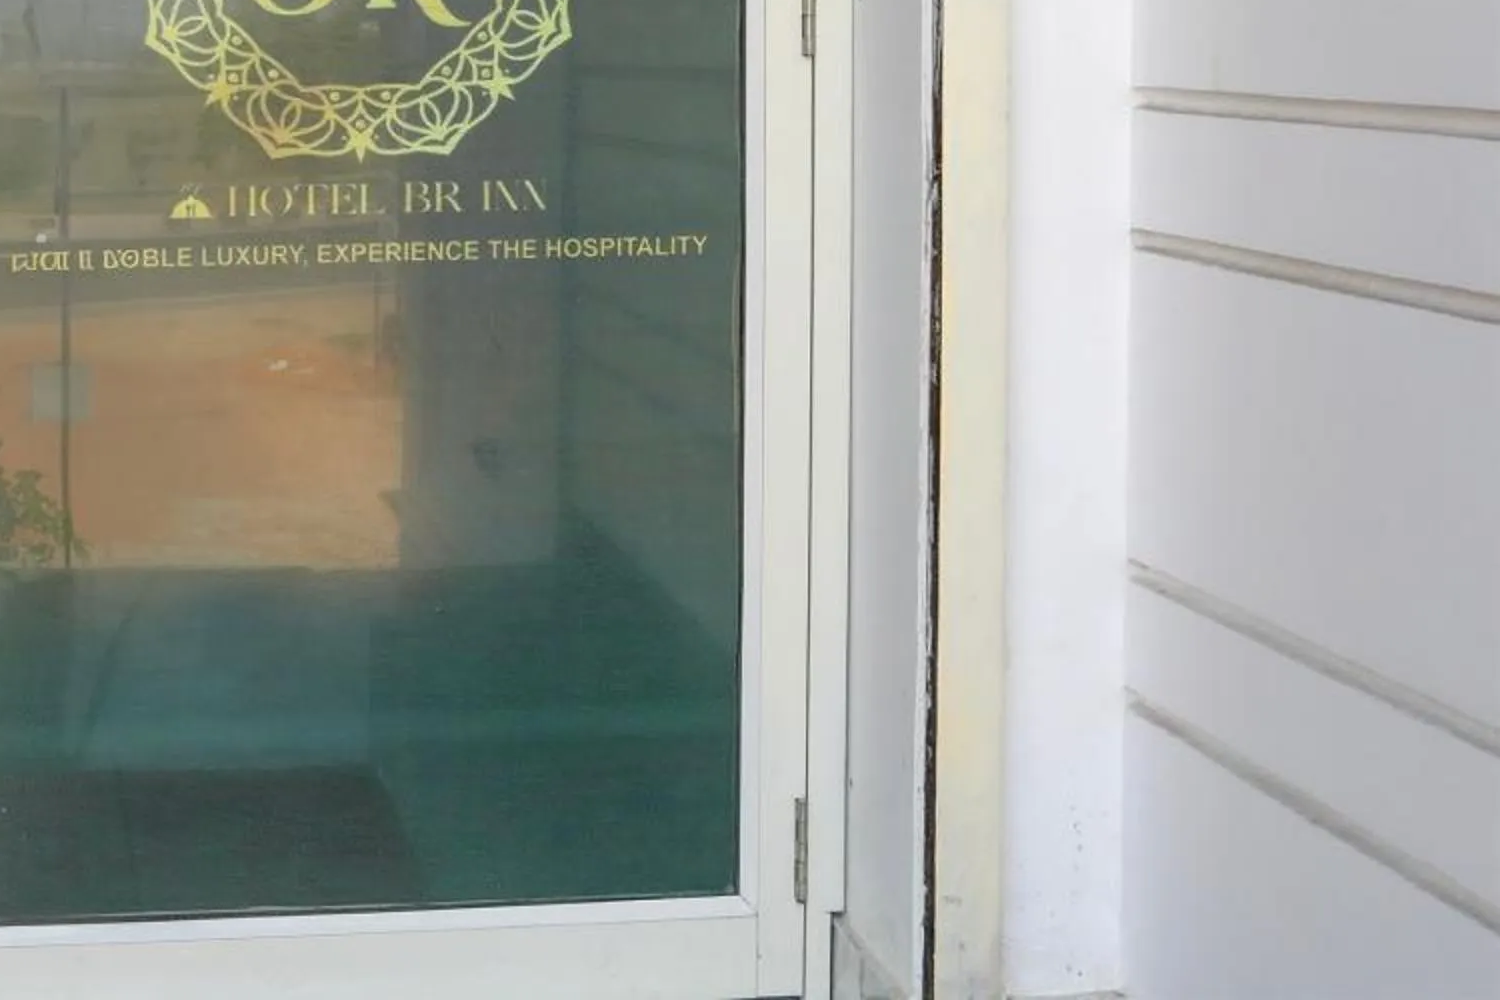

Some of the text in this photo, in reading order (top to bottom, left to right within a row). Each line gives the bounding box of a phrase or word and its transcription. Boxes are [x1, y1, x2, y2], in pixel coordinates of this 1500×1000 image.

[228, 178, 547, 218] HOTEL BR INN
[201, 244, 309, 269] LUXURY,
[316, 240, 480, 264] EXPERIENCE
[487, 238, 537, 260] THE
[545, 234, 708, 259] HOSPITALITY
